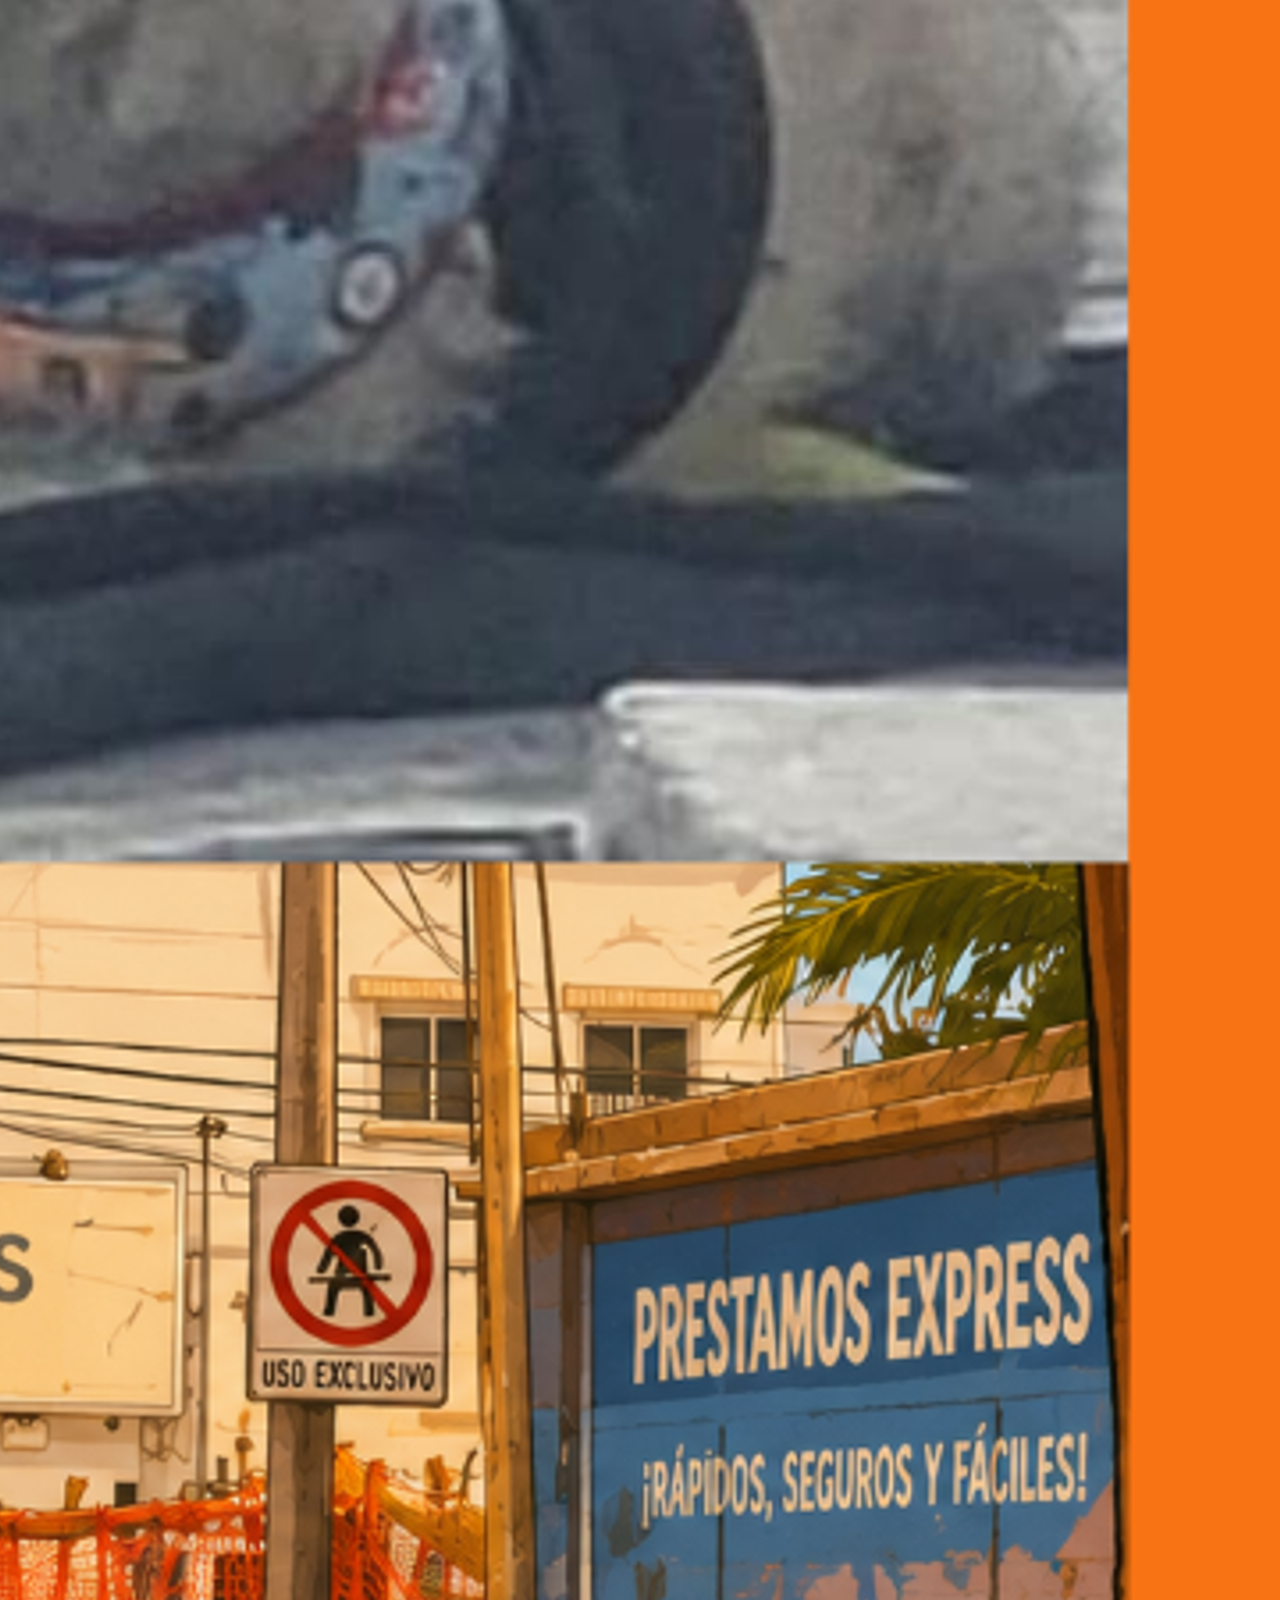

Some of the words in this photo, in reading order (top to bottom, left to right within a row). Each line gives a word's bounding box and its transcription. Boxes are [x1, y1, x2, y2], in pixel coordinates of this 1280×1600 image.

[632, 1260, 872, 1385] PRESTAMOS
[886, 1232, 1092, 1361] EXPRESS
[262, 1358, 306, 1388] USO
[315, 1359, 436, 1392] EXCLUSIVO
[782, 1443, 913, 1513] SEGUROS
[923, 1441, 944, 1506] Y
[953, 1421, 1089, 1506] FÁCILES!
